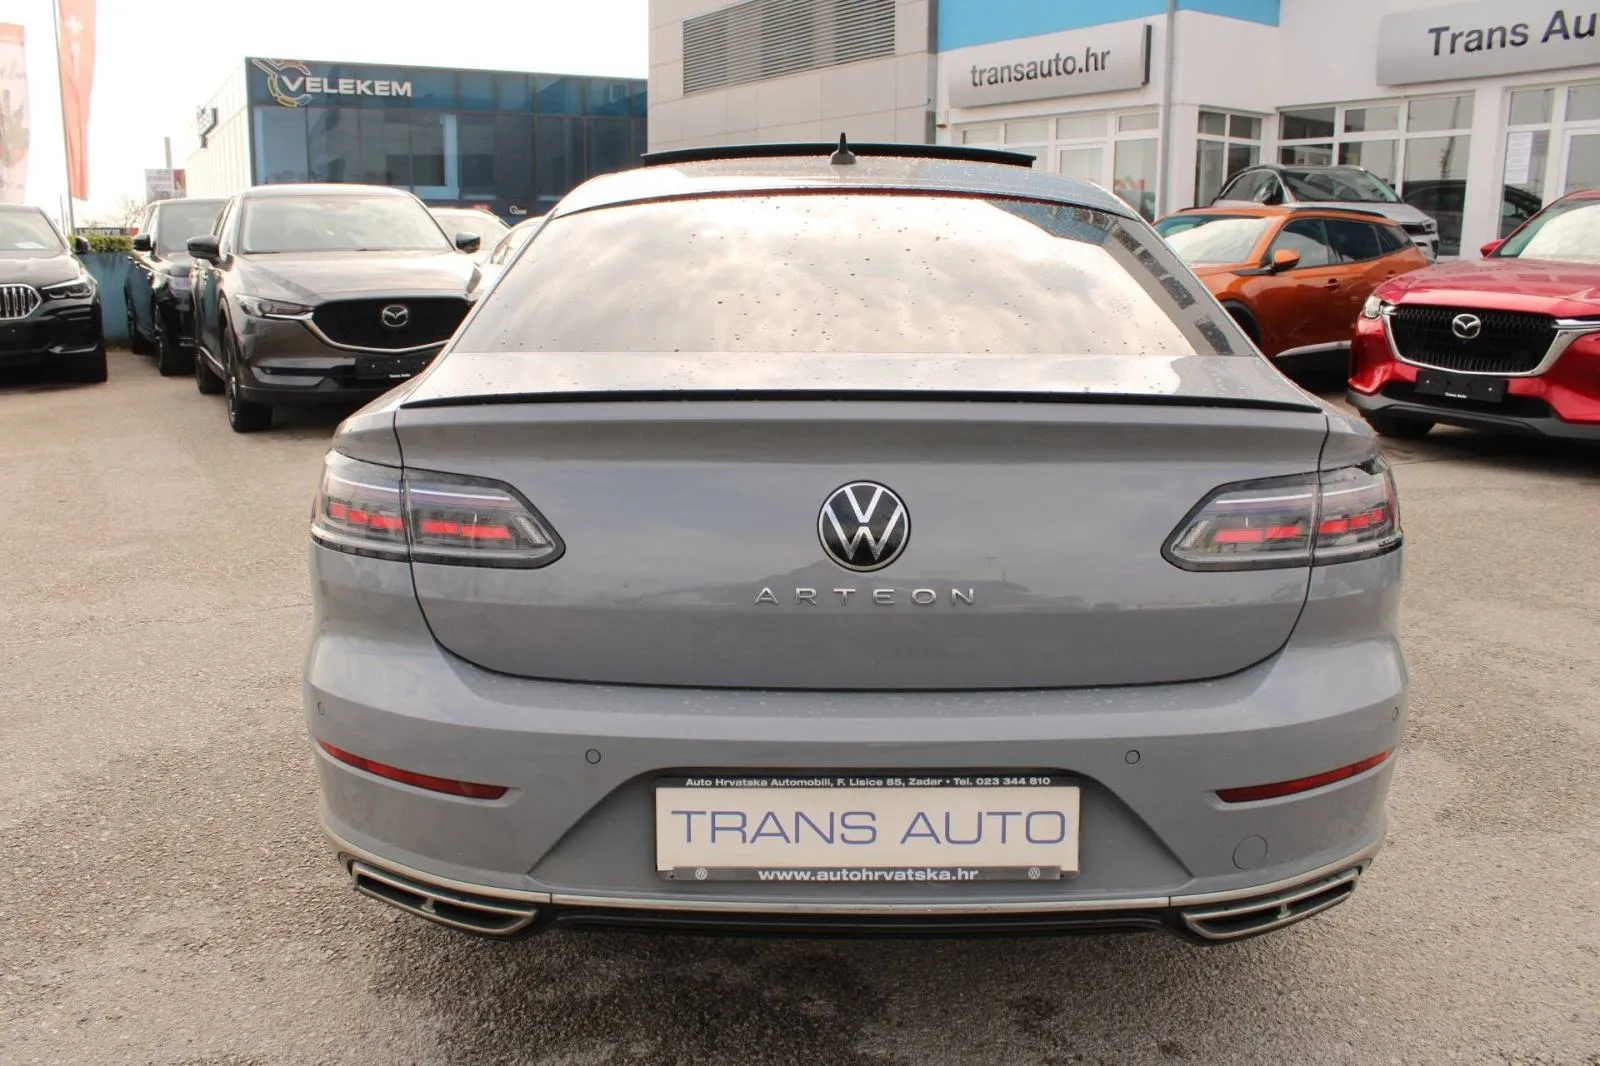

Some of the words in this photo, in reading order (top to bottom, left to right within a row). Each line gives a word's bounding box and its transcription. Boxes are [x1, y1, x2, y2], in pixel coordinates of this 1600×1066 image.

[1428, 22, 1529, 56] Trans
[970, 46, 1111, 87] transauto.hr
[280, 75, 412, 97] VELEKEM
[754, 587, 975, 605] ARTEON
[685, 777, 712, 787] Auto
[715, 777, 768, 787] Hrvatska
[770, 777, 834, 788] Automobili,
[837, 777, 846, 786] F.
[849, 777, 883, 786] Lisice
[886, 777, 905, 787] 85,
[908, 777, 943, 786] Zadar
[953, 777, 973, 786] Tel.
[976, 777, 1000, 786] 023
[1002, 777, 1026, 786] 344
[671, 811, 878, 845] TRANS
[900, 811, 1066, 845] AUTO
[758, 868, 979, 881] www.autohrvatska.hr
